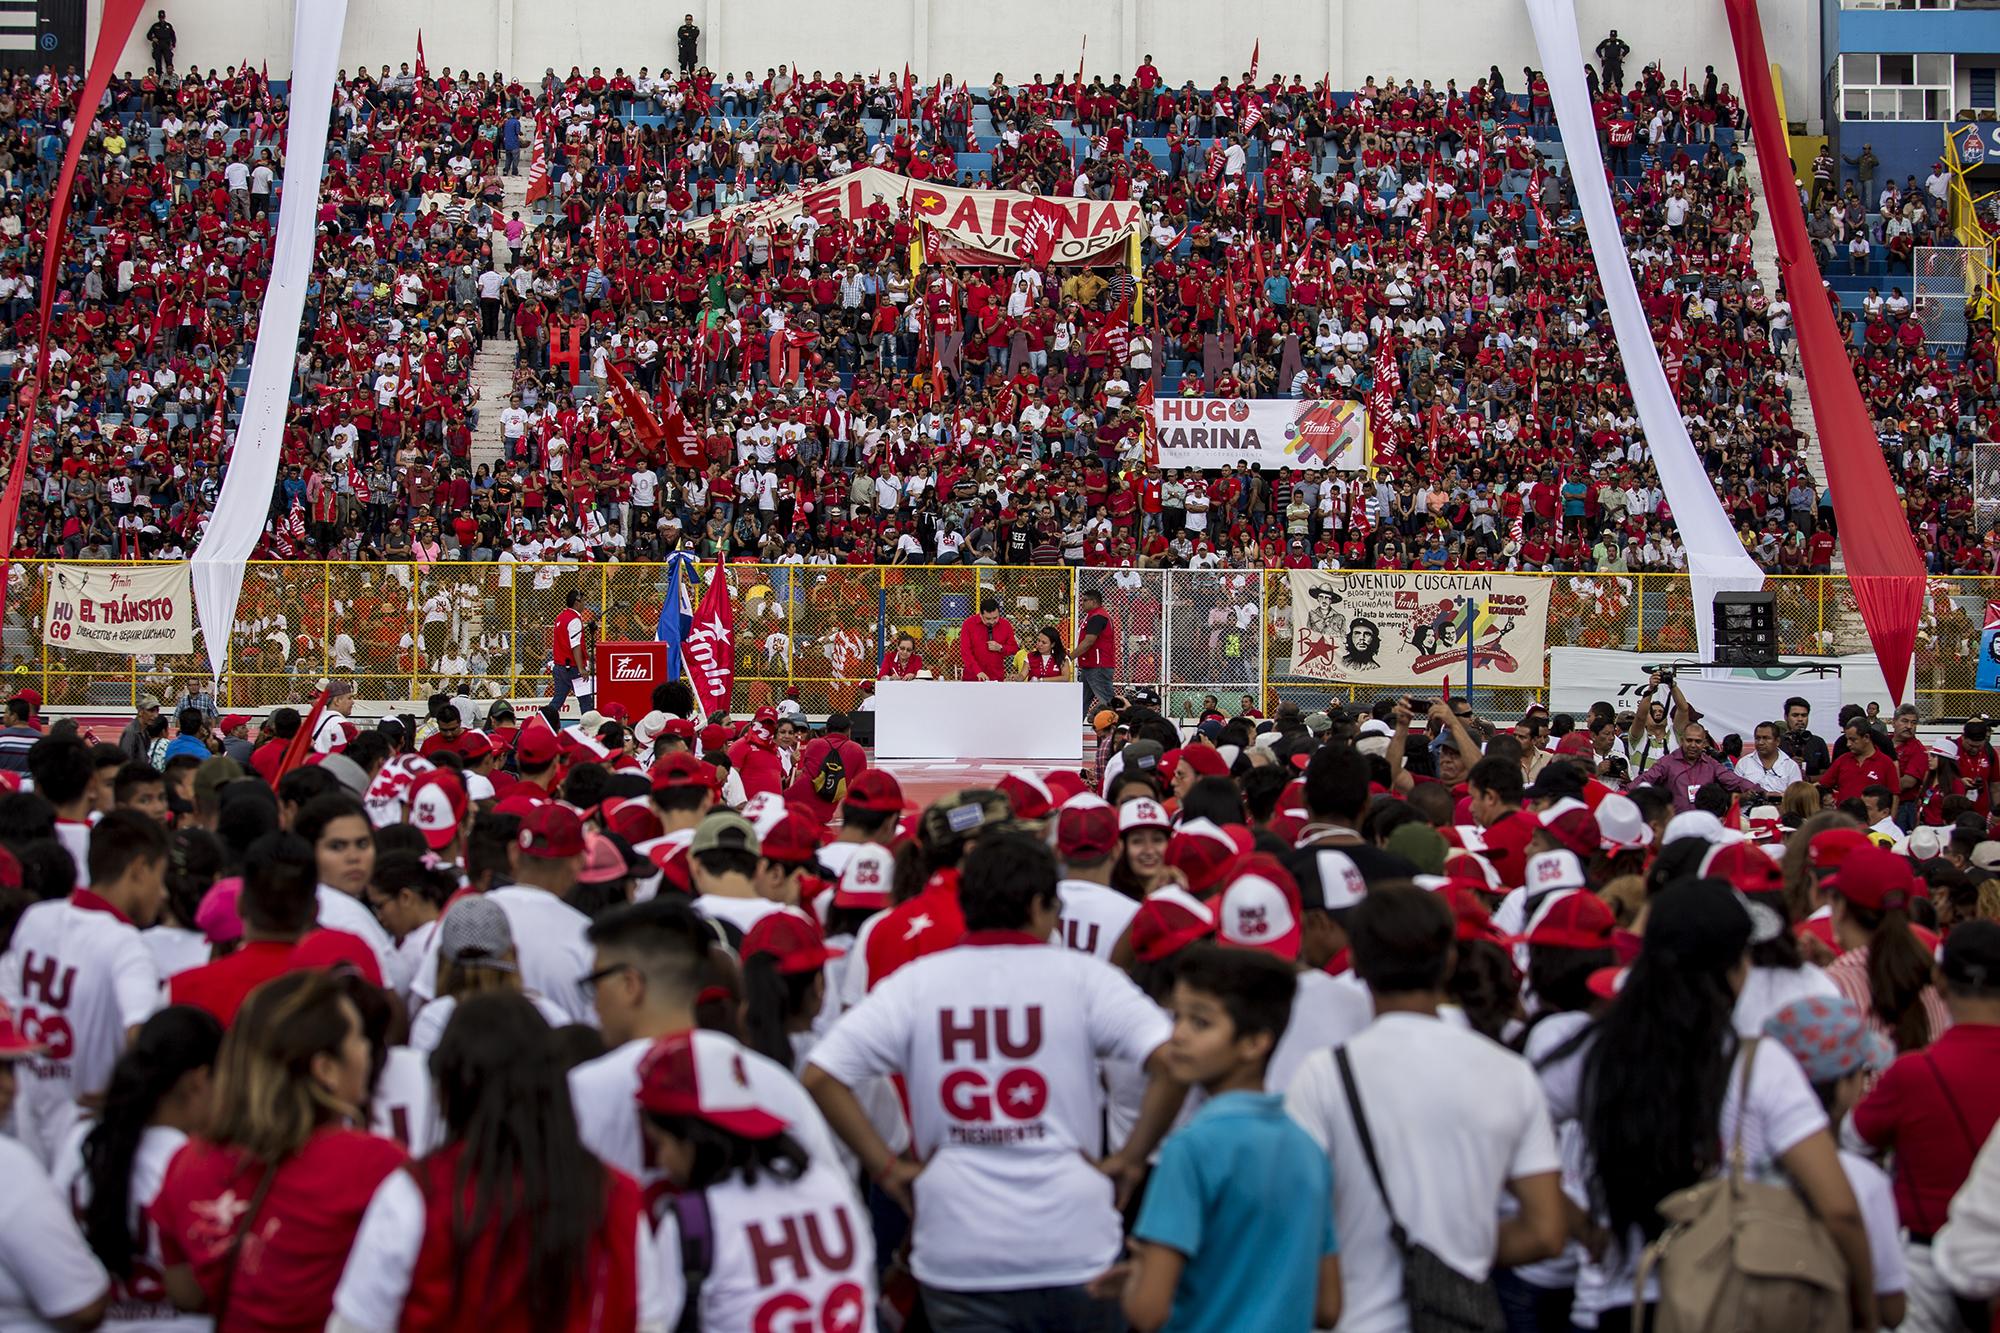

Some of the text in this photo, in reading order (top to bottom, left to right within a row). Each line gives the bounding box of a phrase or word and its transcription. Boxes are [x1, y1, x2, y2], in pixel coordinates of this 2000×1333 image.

[1163, 400, 1250, 422] HUGO
[1156, 427, 1262, 450] KARINA
[1338, 574, 1492, 592] JUVENTUD CUSCATLAN
[53, 601, 74, 622] HU
[79, 593, 173, 624] EL TRÁNSITO
[50, 621, 71, 641] GO
[615, 663, 648, 679] fmln
[685, 627, 731, 697] fmln
[22, 948, 78, 1010] HU
[939, 1005, 1043, 1061] HU
[940, 1067, 1049, 1121] GO
[948, 1121, 1047, 1145] PRESIDENTE
[746, 1205, 856, 1287] HU
[752, 1281, 865, 1333] GO
